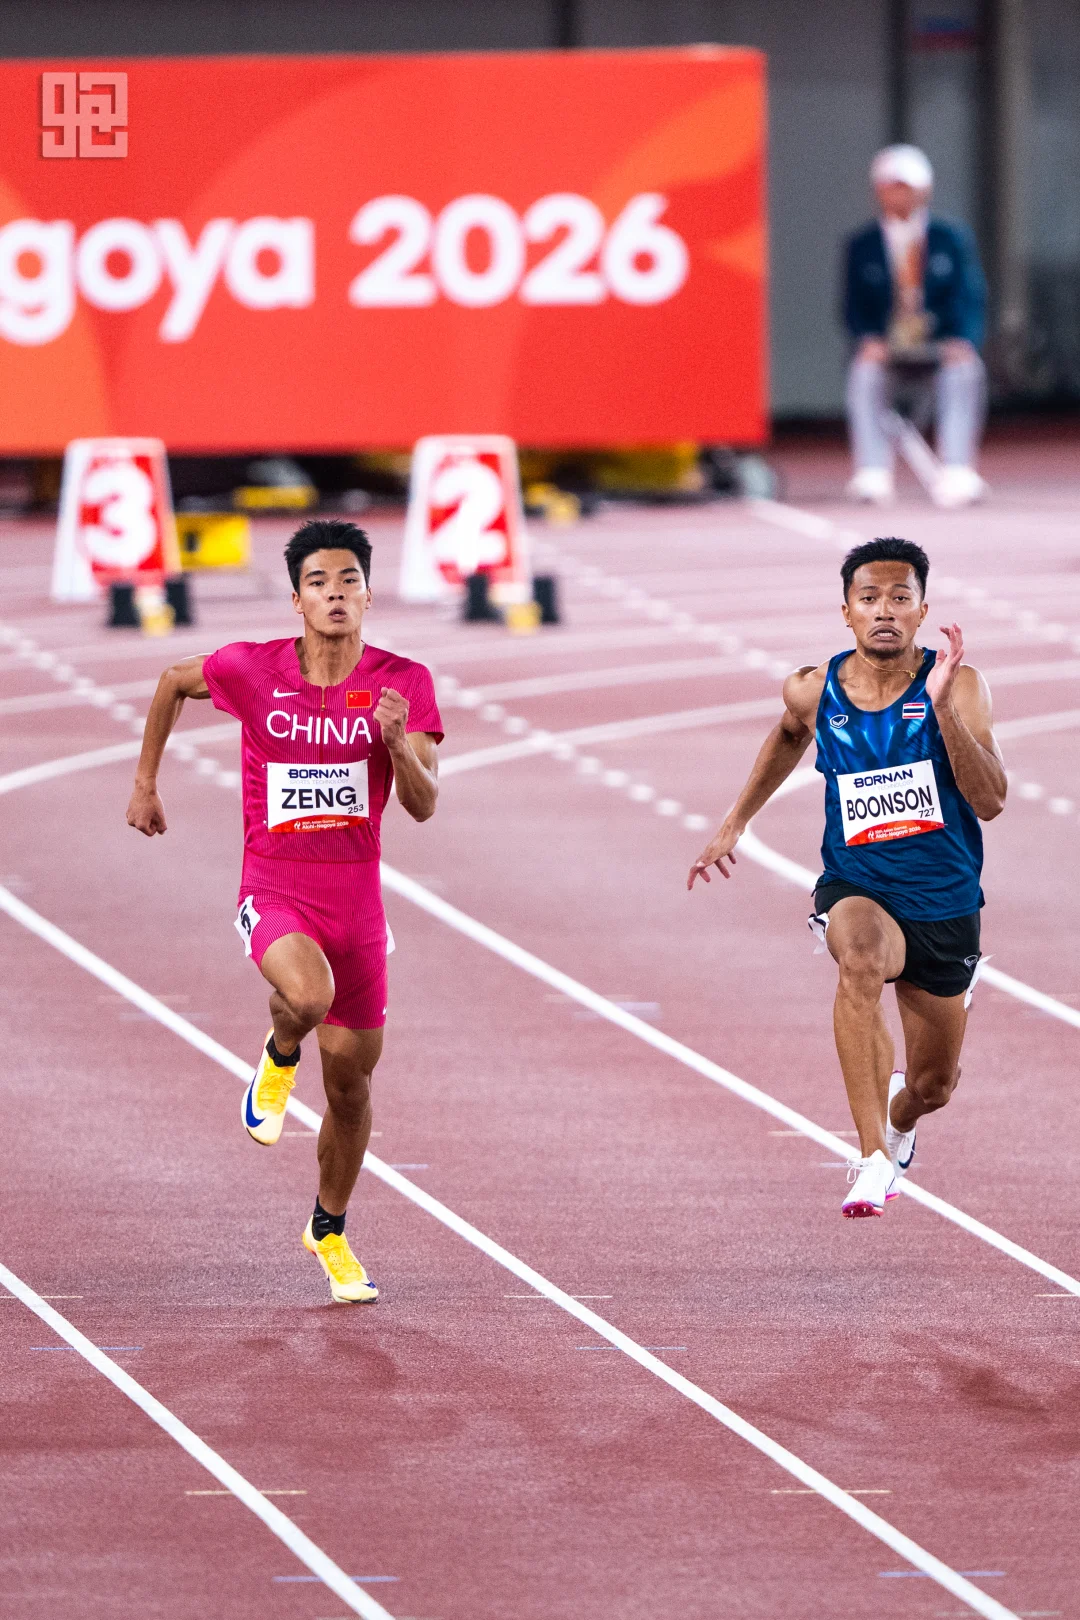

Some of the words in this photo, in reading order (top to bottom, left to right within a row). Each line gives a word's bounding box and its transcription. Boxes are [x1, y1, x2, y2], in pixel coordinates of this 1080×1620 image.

[0, 216, 315, 345] goya
[349, 193, 690, 307] 2026
[81, 463, 157, 568] 3
[430, 463, 507, 567] 2
[266, 710, 373, 745] CHINA
[287, 768, 349, 778] BORNAN
[853, 769, 913, 788] BORNAN
[281, 786, 357, 809] ZENG
[348, 804, 364, 814] 253
[846, 785, 933, 821] BOONSON
[918, 808, 935, 819] 727
